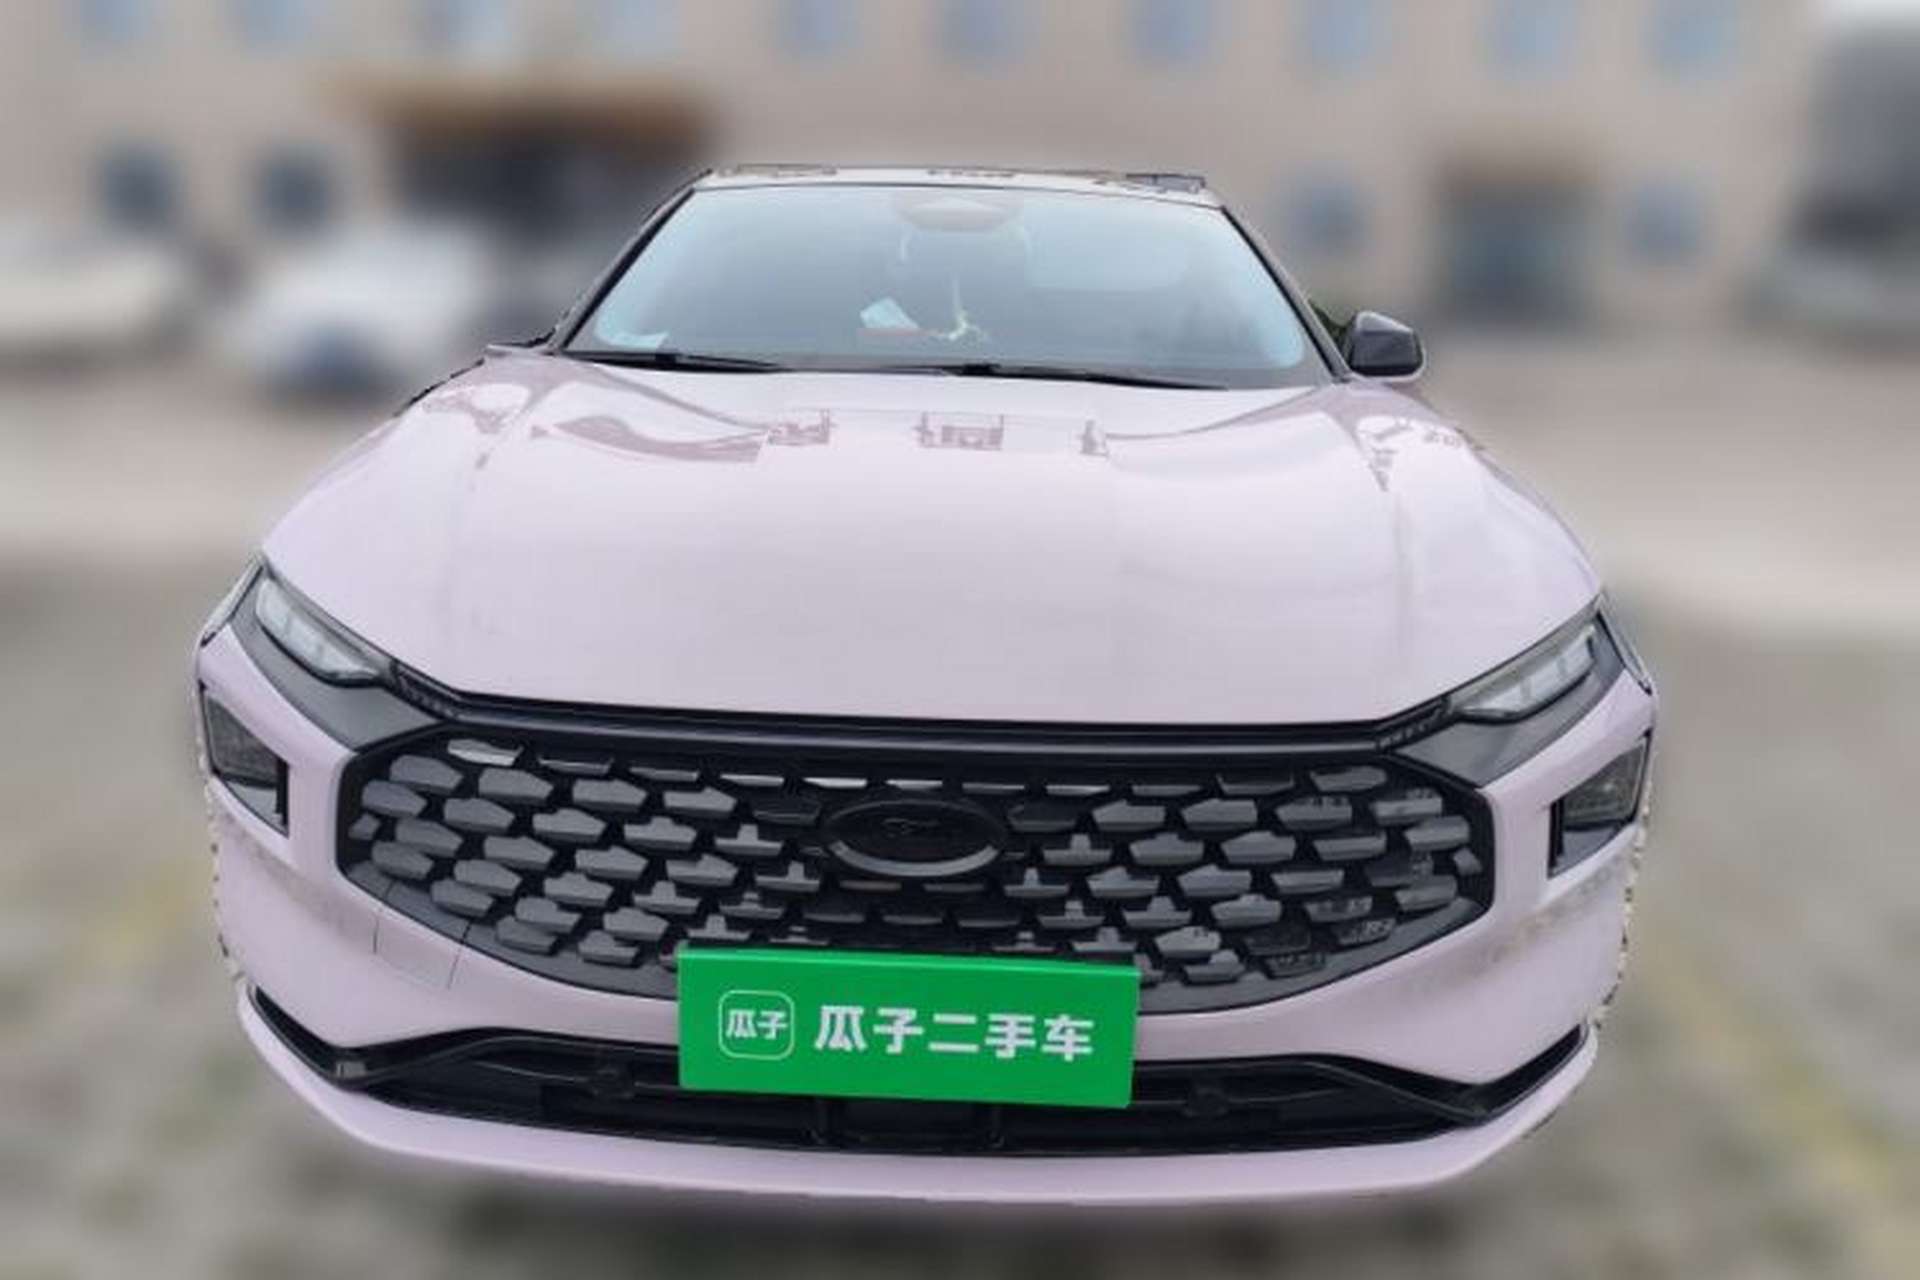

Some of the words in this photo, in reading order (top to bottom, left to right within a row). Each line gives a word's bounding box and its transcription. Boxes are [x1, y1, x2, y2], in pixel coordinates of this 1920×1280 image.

[726, 1009, 788, 1040] 瓜子
[815, 1005, 1093, 1061] 瓜子二手车
